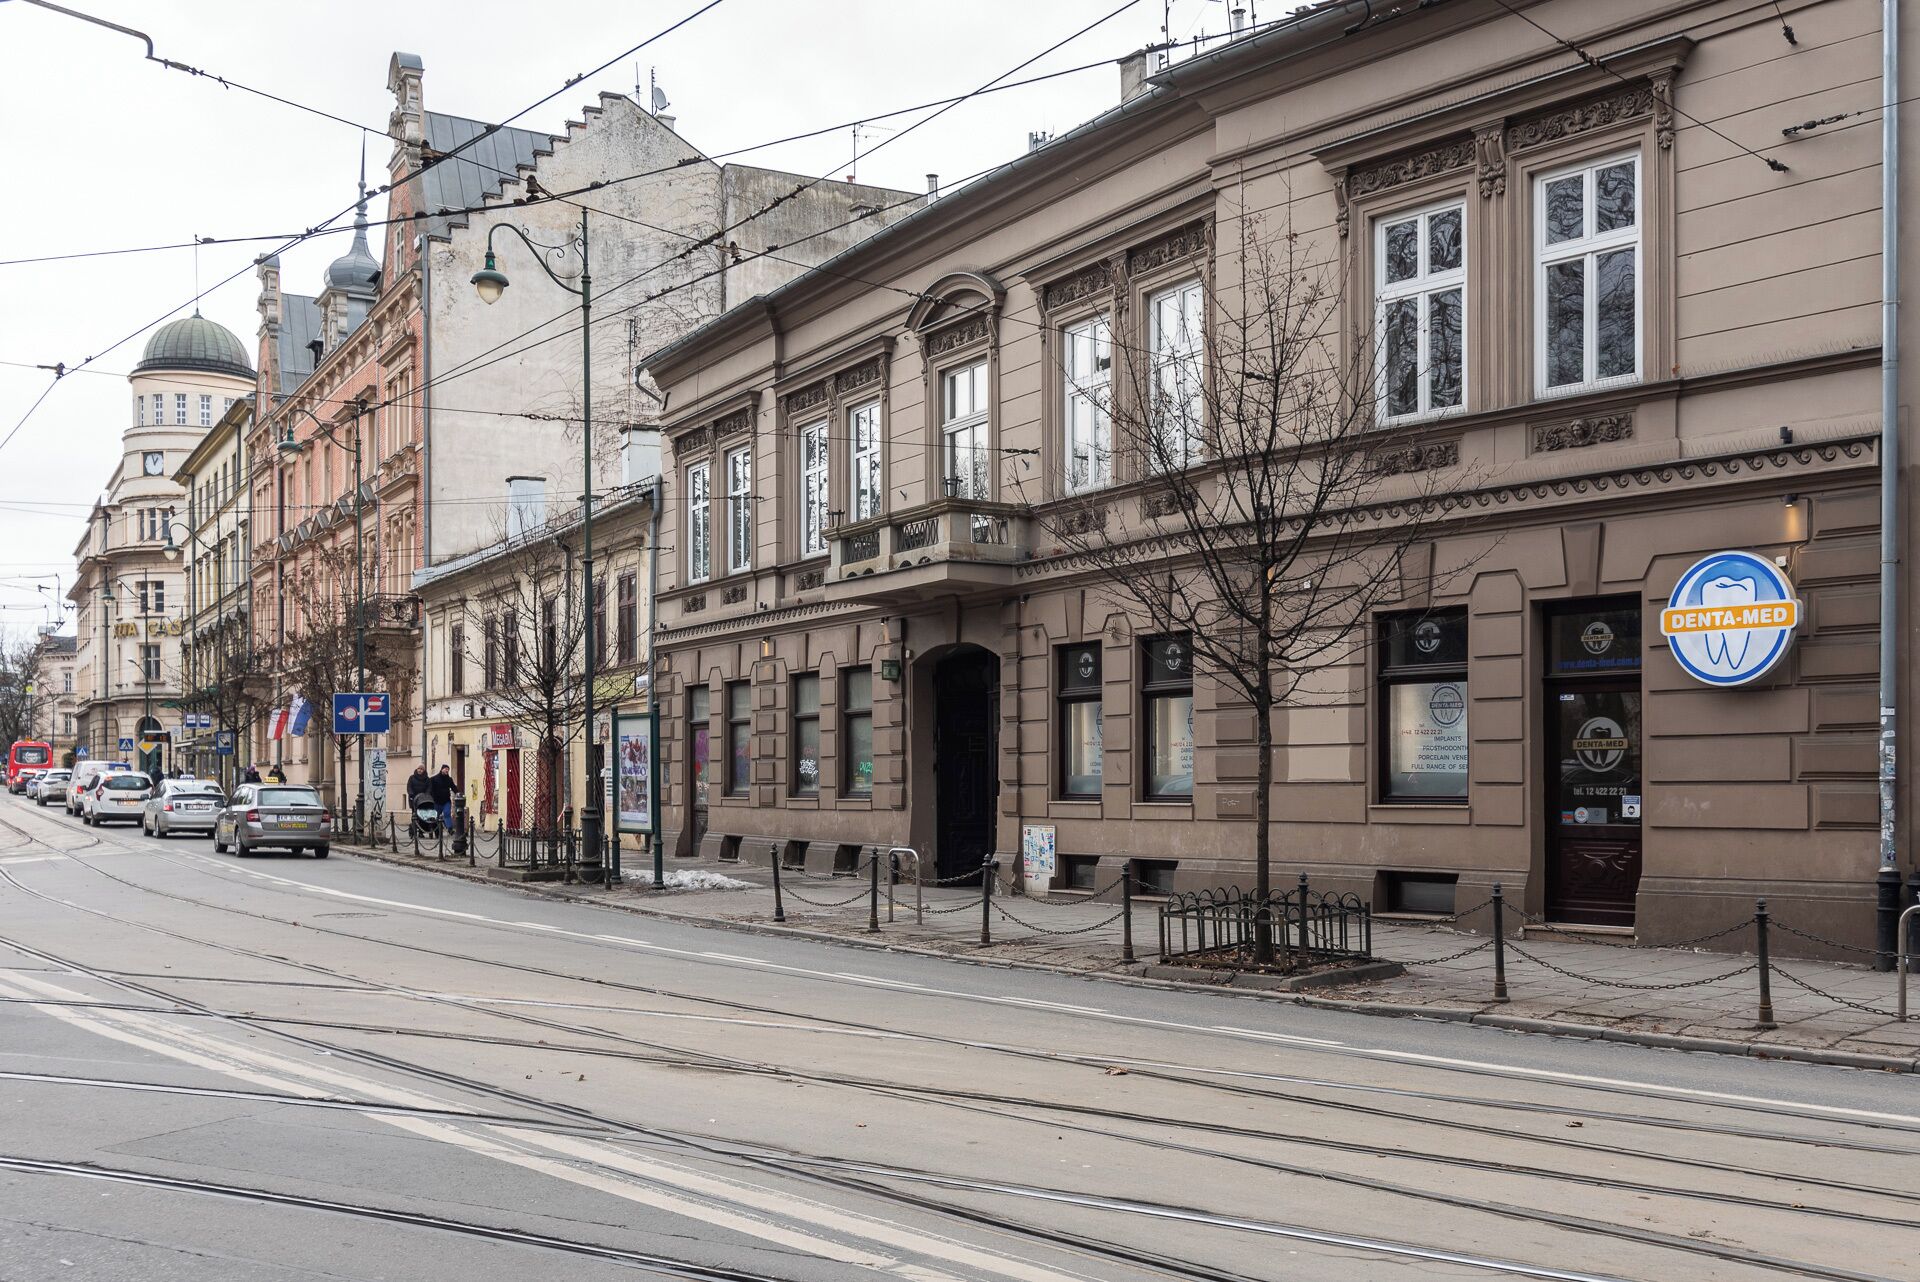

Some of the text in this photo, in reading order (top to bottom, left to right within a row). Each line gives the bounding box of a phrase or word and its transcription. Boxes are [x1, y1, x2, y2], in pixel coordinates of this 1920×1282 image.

[1671, 606, 1788, 629] DENTA-MED
[1576, 740, 1624, 748] DENTA-MED
[1586, 787, 1594, 796] 12
[1595, 787, 1608, 796] 422
[1608, 787, 1618, 796] 22
[1618, 787, 1627, 796] 21
